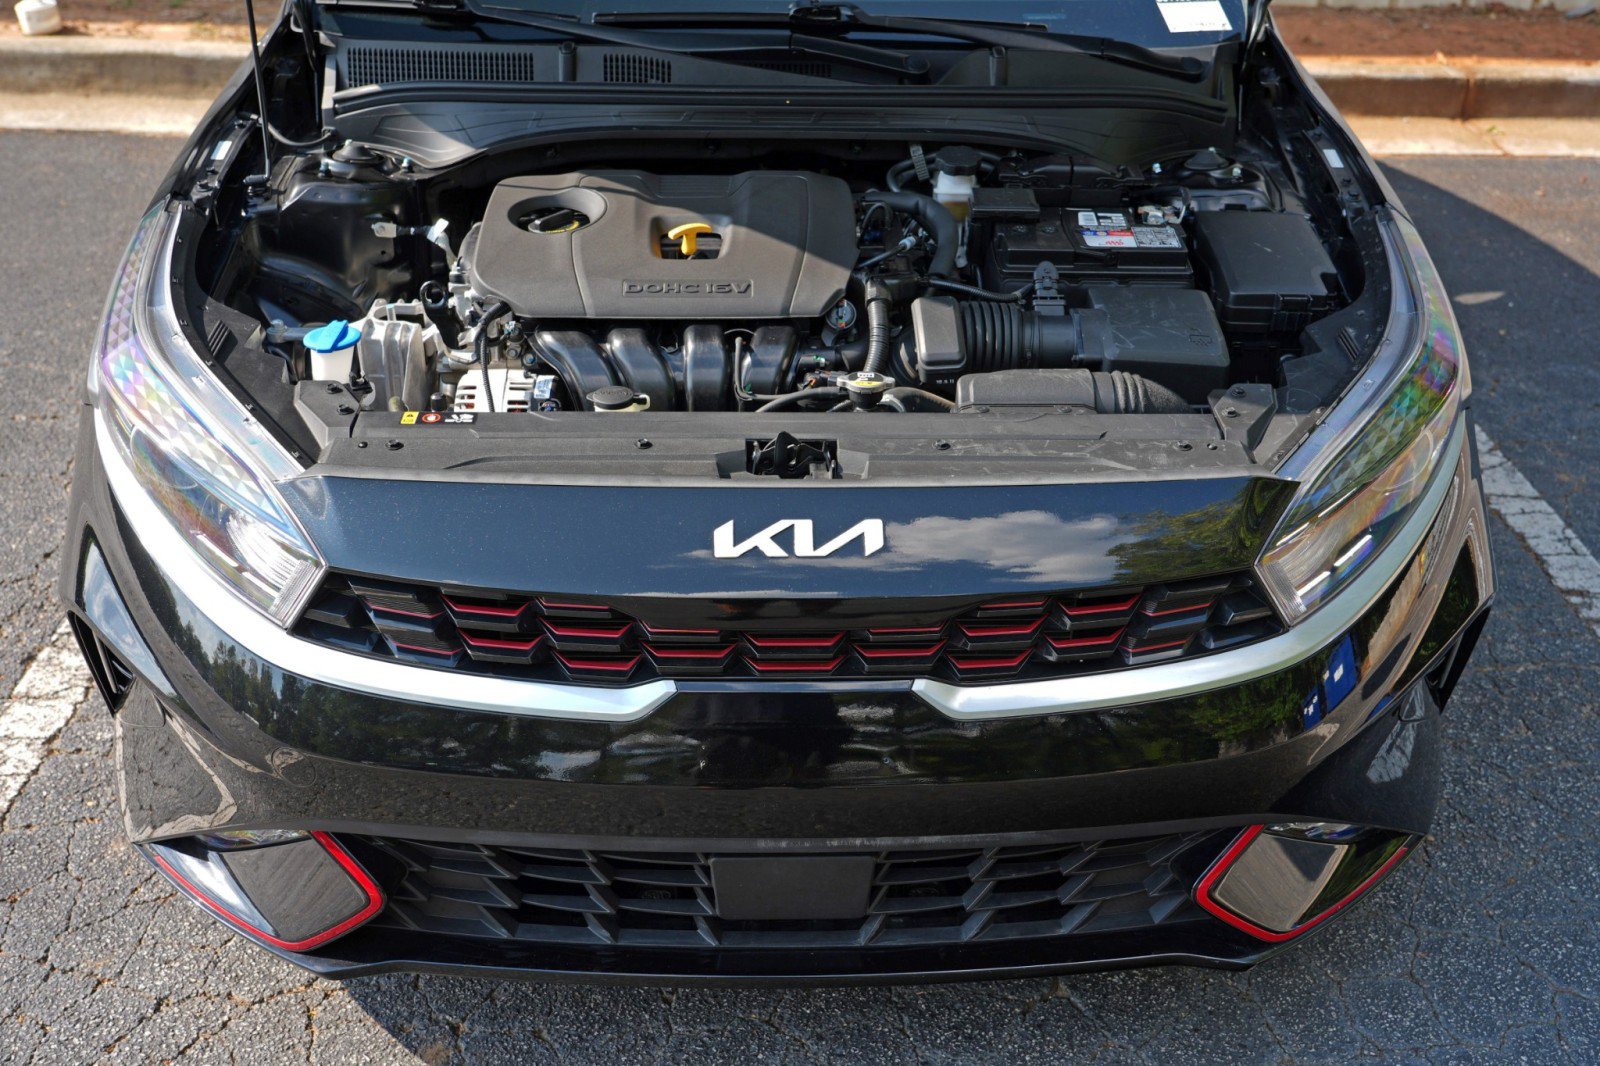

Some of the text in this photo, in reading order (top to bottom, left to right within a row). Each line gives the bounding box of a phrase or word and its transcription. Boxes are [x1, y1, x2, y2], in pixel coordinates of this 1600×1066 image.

[624, 282, 751, 294] DOHC 16V
[713, 518, 884, 558] KIA
